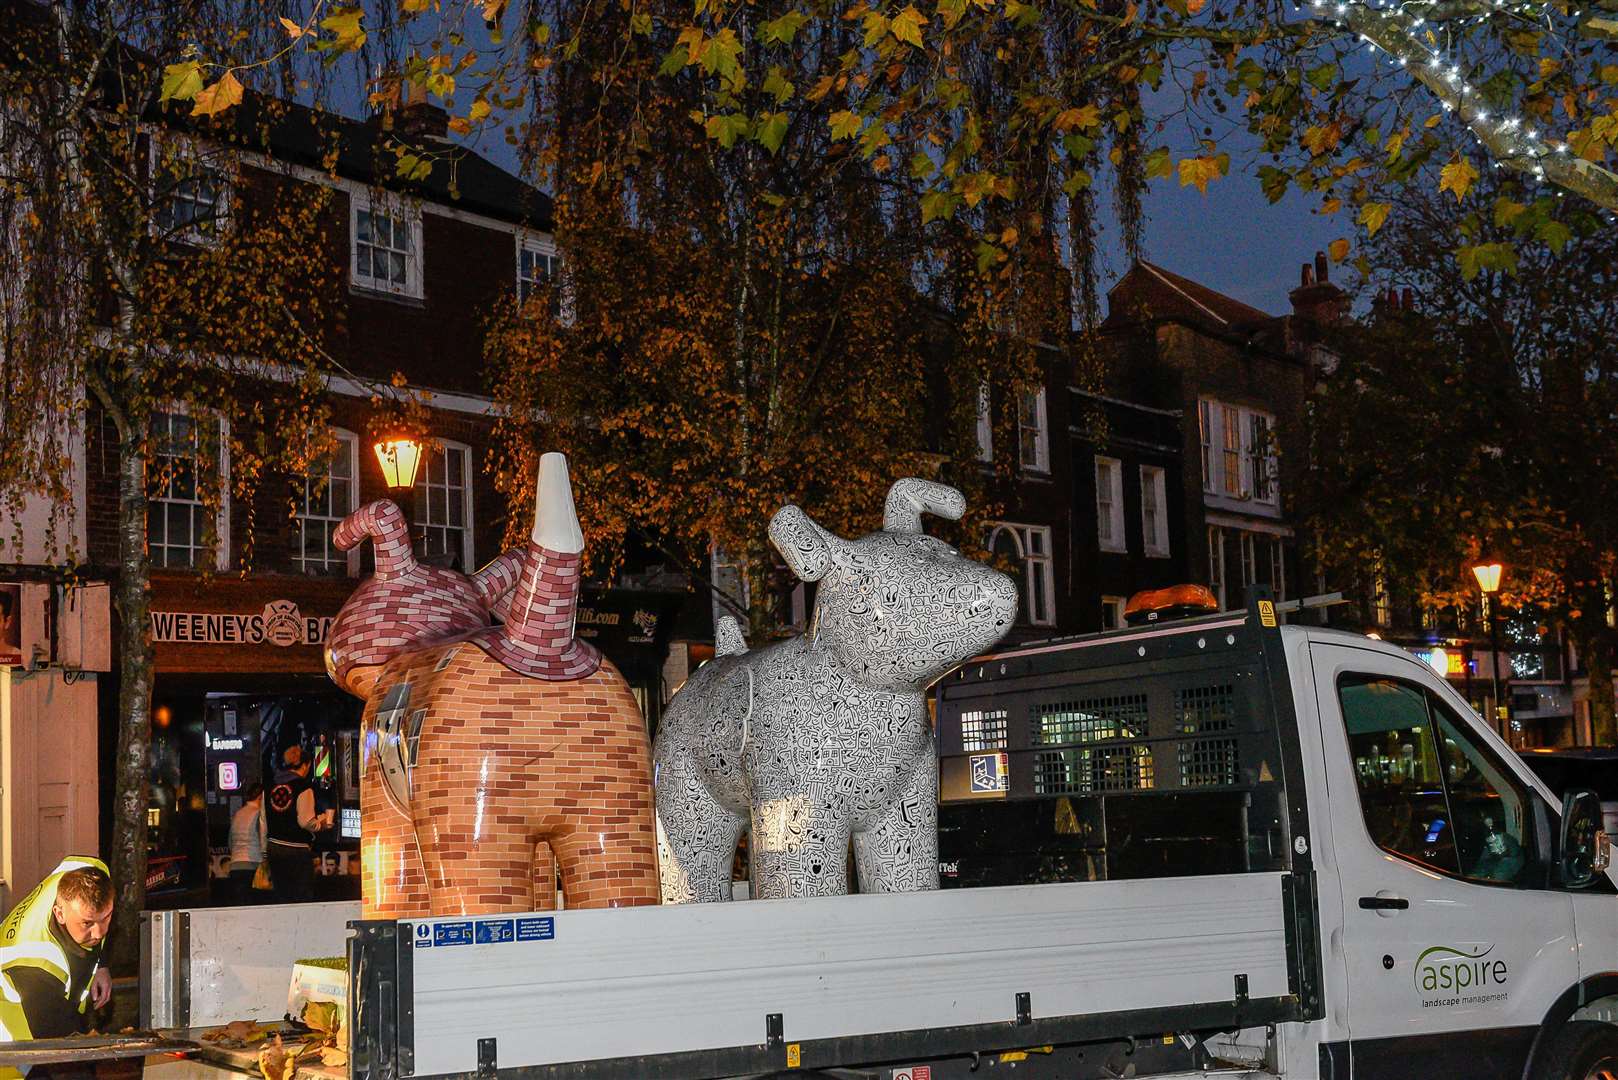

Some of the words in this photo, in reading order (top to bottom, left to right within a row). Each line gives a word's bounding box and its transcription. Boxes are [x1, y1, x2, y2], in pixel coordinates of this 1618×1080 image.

[1422, 947, 1508, 994] aspire
[1422, 997, 1460, 1008] landscape
[1461, 993, 1508, 1005] management
